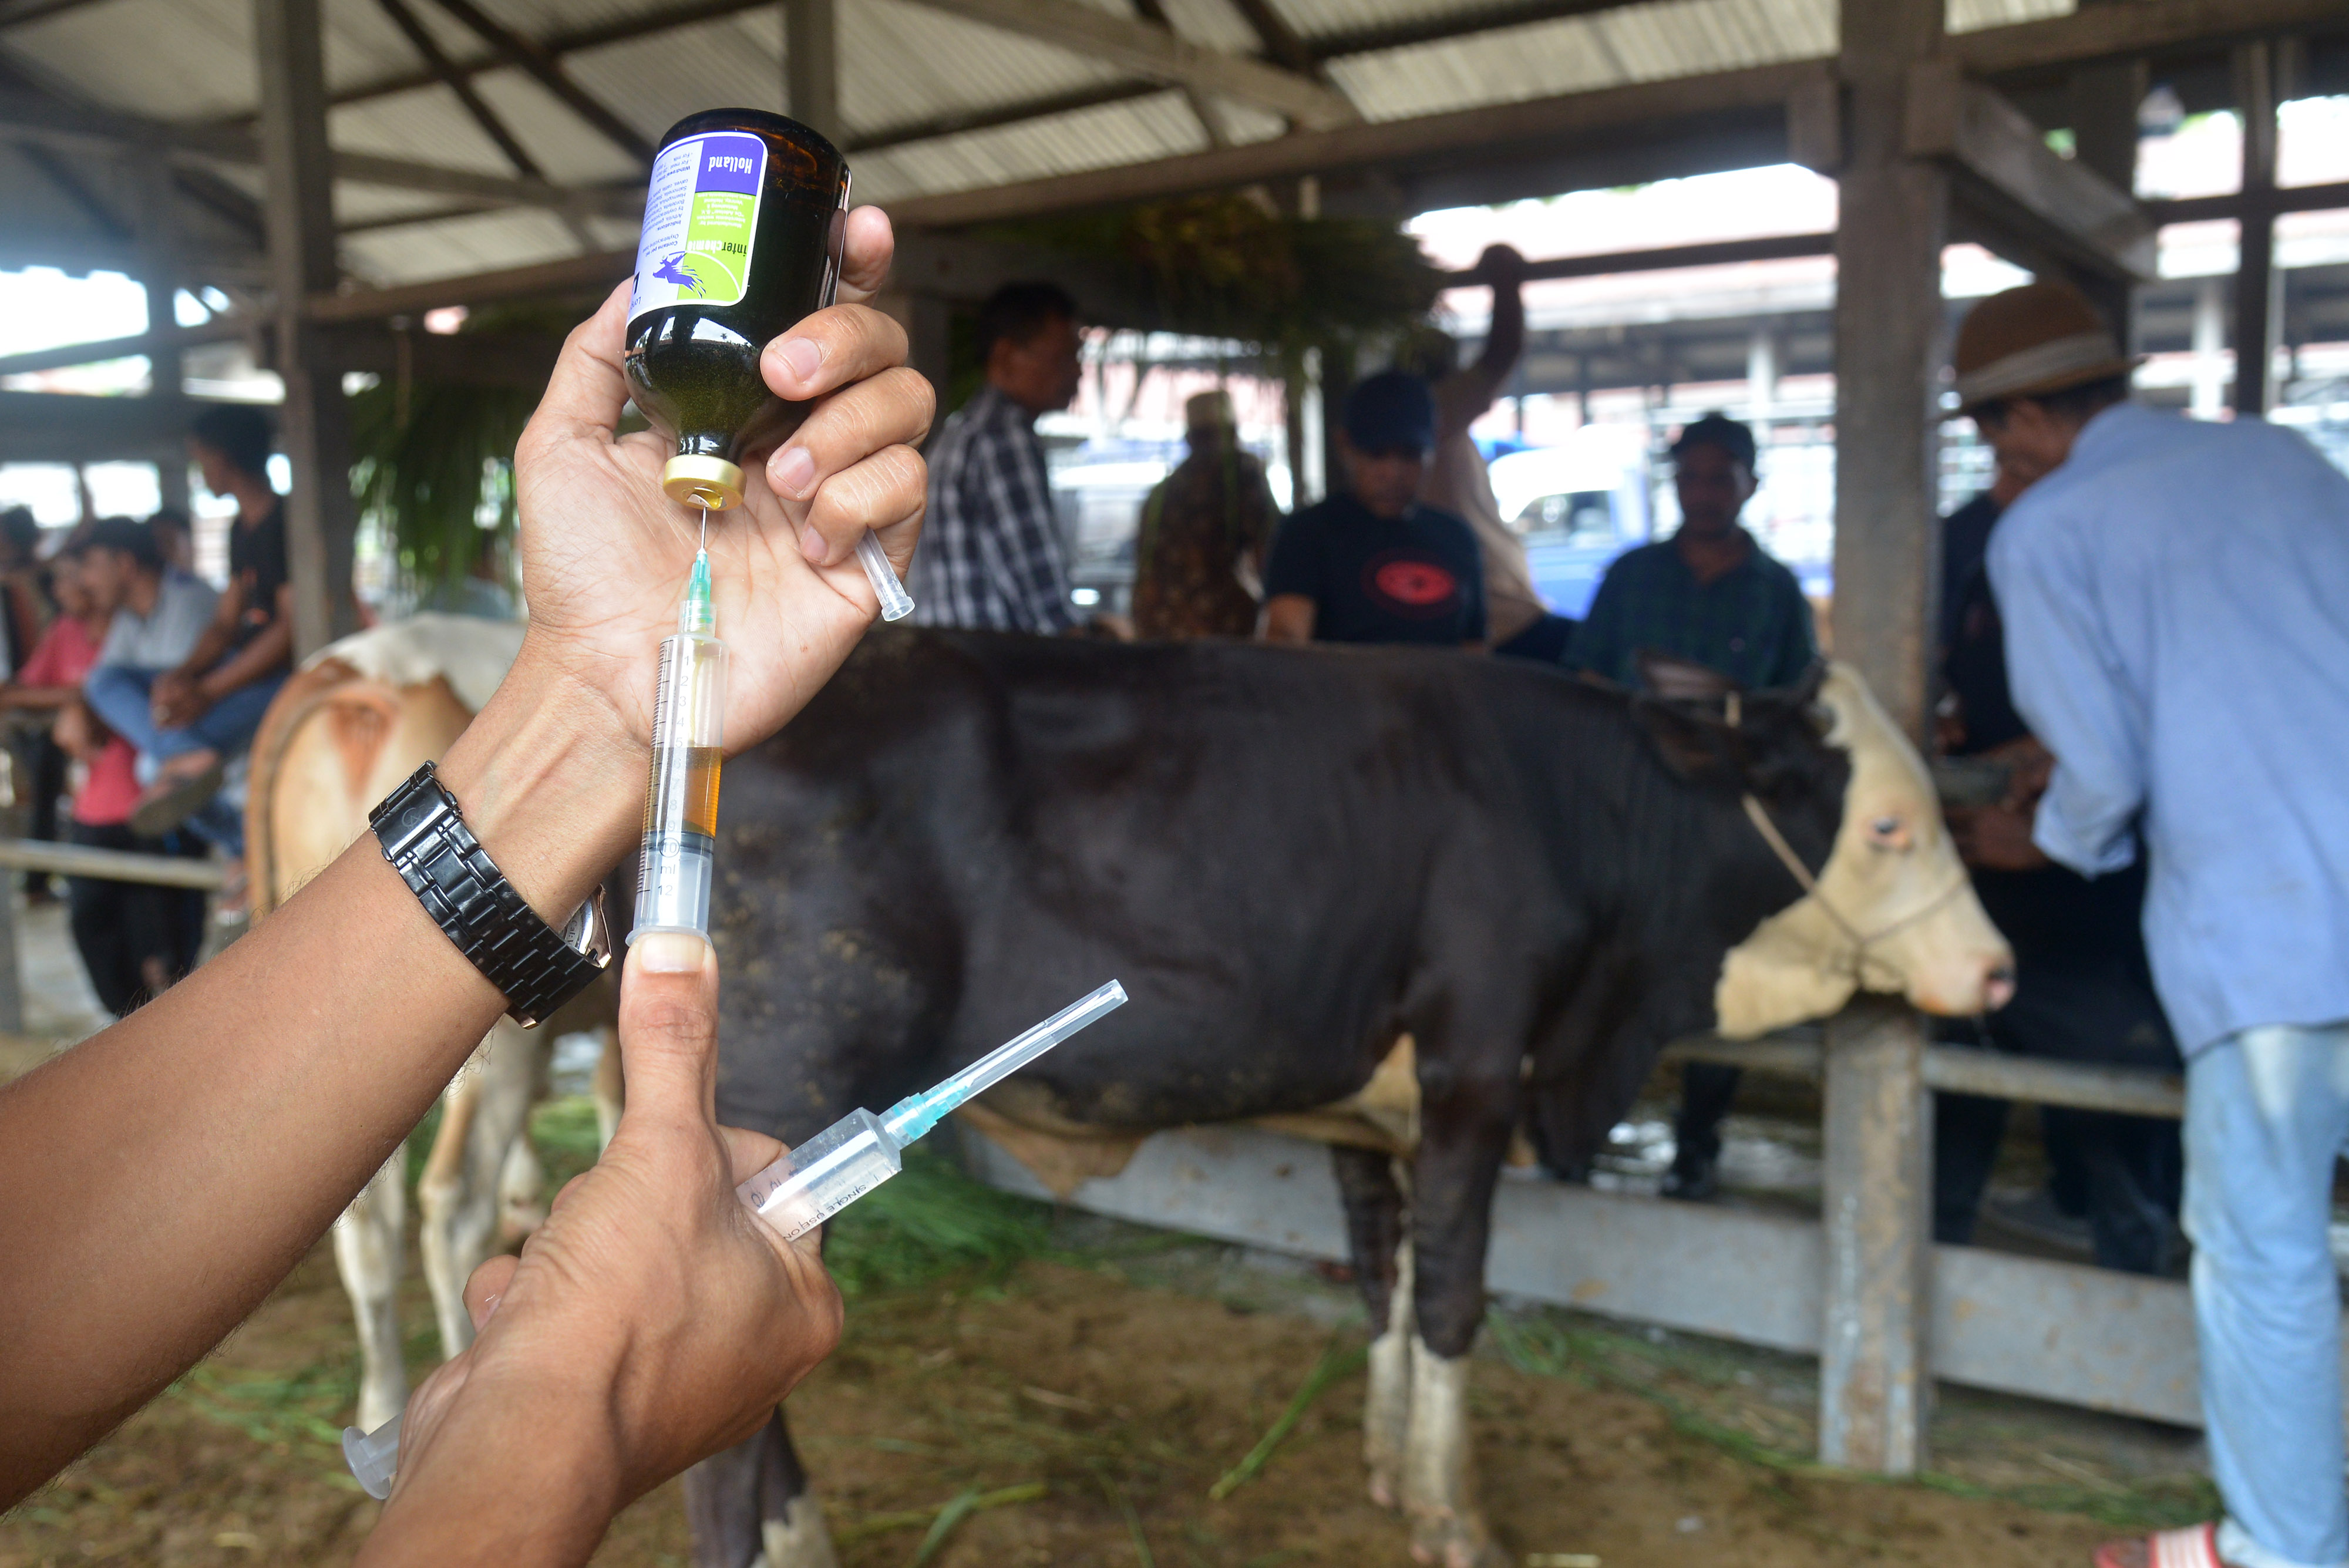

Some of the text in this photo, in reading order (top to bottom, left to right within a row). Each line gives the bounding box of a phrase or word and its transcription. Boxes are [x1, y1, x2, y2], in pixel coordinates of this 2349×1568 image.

[708, 156, 752, 174] Holland
[684, 655, 689, 666] 1
[681, 676, 688, 686] 2
[679, 696, 686, 706] 3
[677, 717, 684, 727] 4
[675, 737, 682, 748] 5
[669, 799, 677, 810] 8
[667, 820, 675, 832] 9
[664, 842, 677, 853] 10
[661, 864, 675, 874] ml
[658, 885, 673, 896] 12
[783, 1185, 866, 1240] SINGLE USE ON
